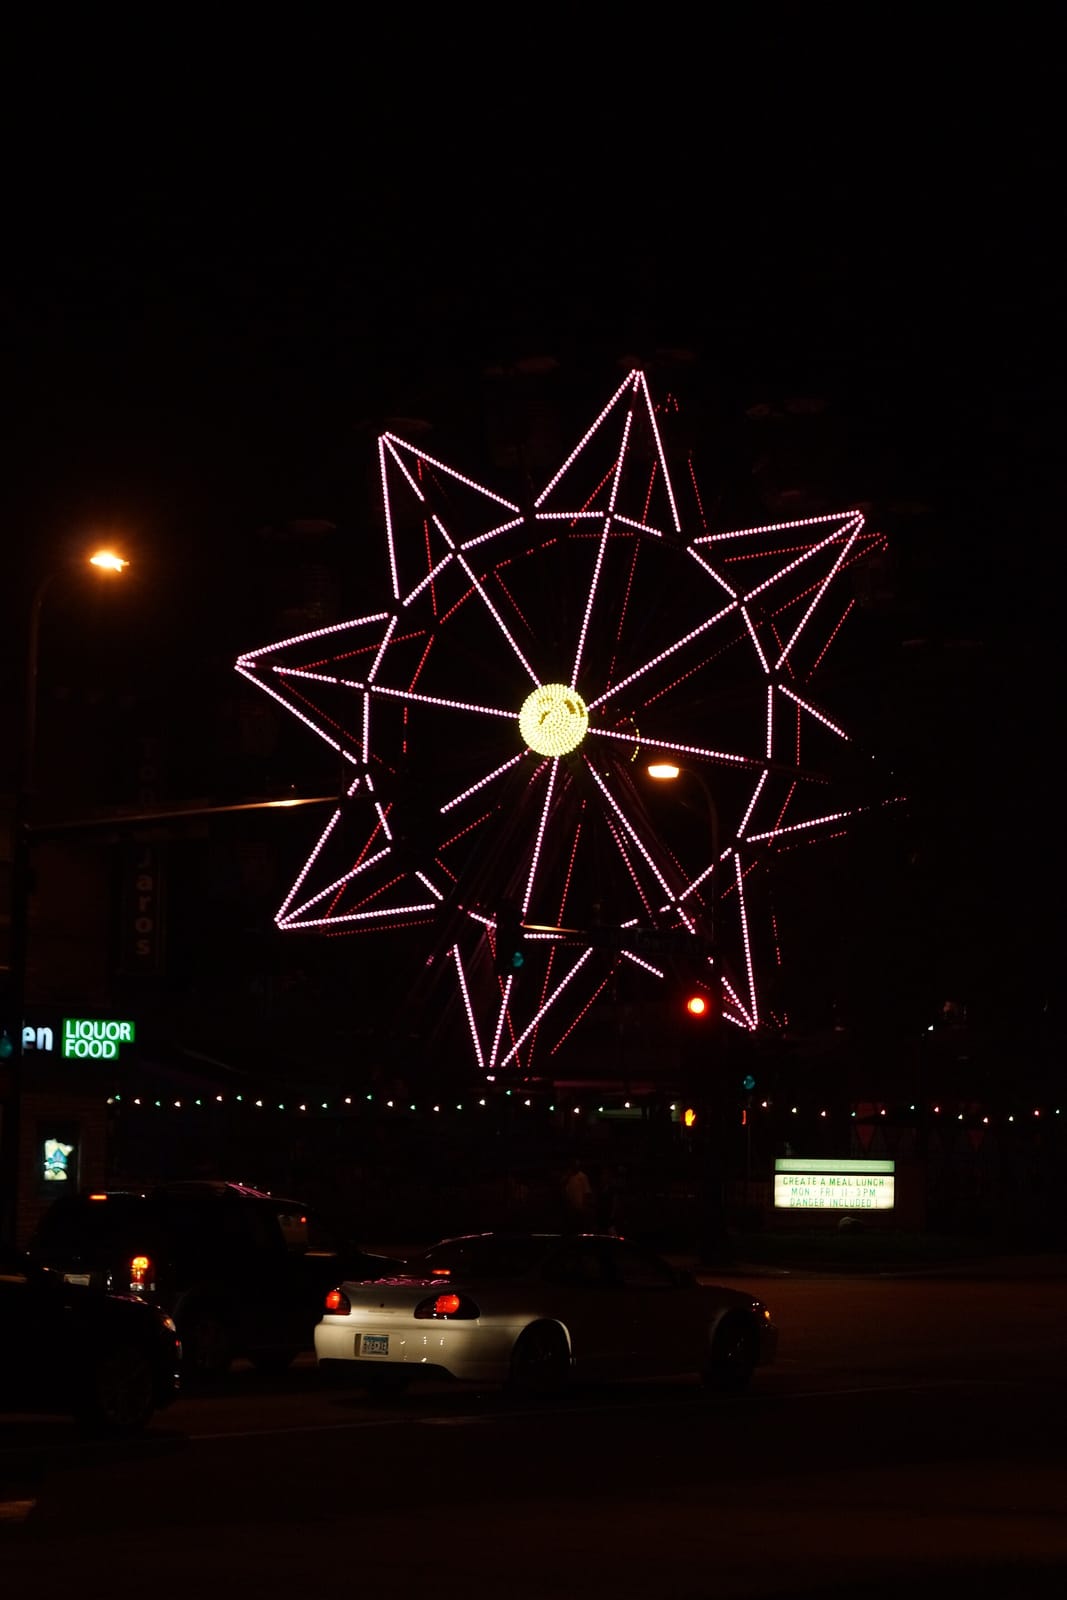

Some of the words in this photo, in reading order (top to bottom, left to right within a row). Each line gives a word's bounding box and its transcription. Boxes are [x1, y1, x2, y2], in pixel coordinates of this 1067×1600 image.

[65, 1019, 131, 1041] LIQUOR
[22, 1026, 53, 1051] en
[65, 1038, 116, 1059] FOOD
[783, 1177, 817, 1186] CREATE
[820, 1177, 826, 1186] A
[829, 1177, 853, 1186] MEAL
[855, 1178, 885, 1187] LUNCH
[791, 1187, 810, 1196] MON
[820, 1187, 834, 1197] FRI
[829, 1198, 872, 1208] INCLUDED
